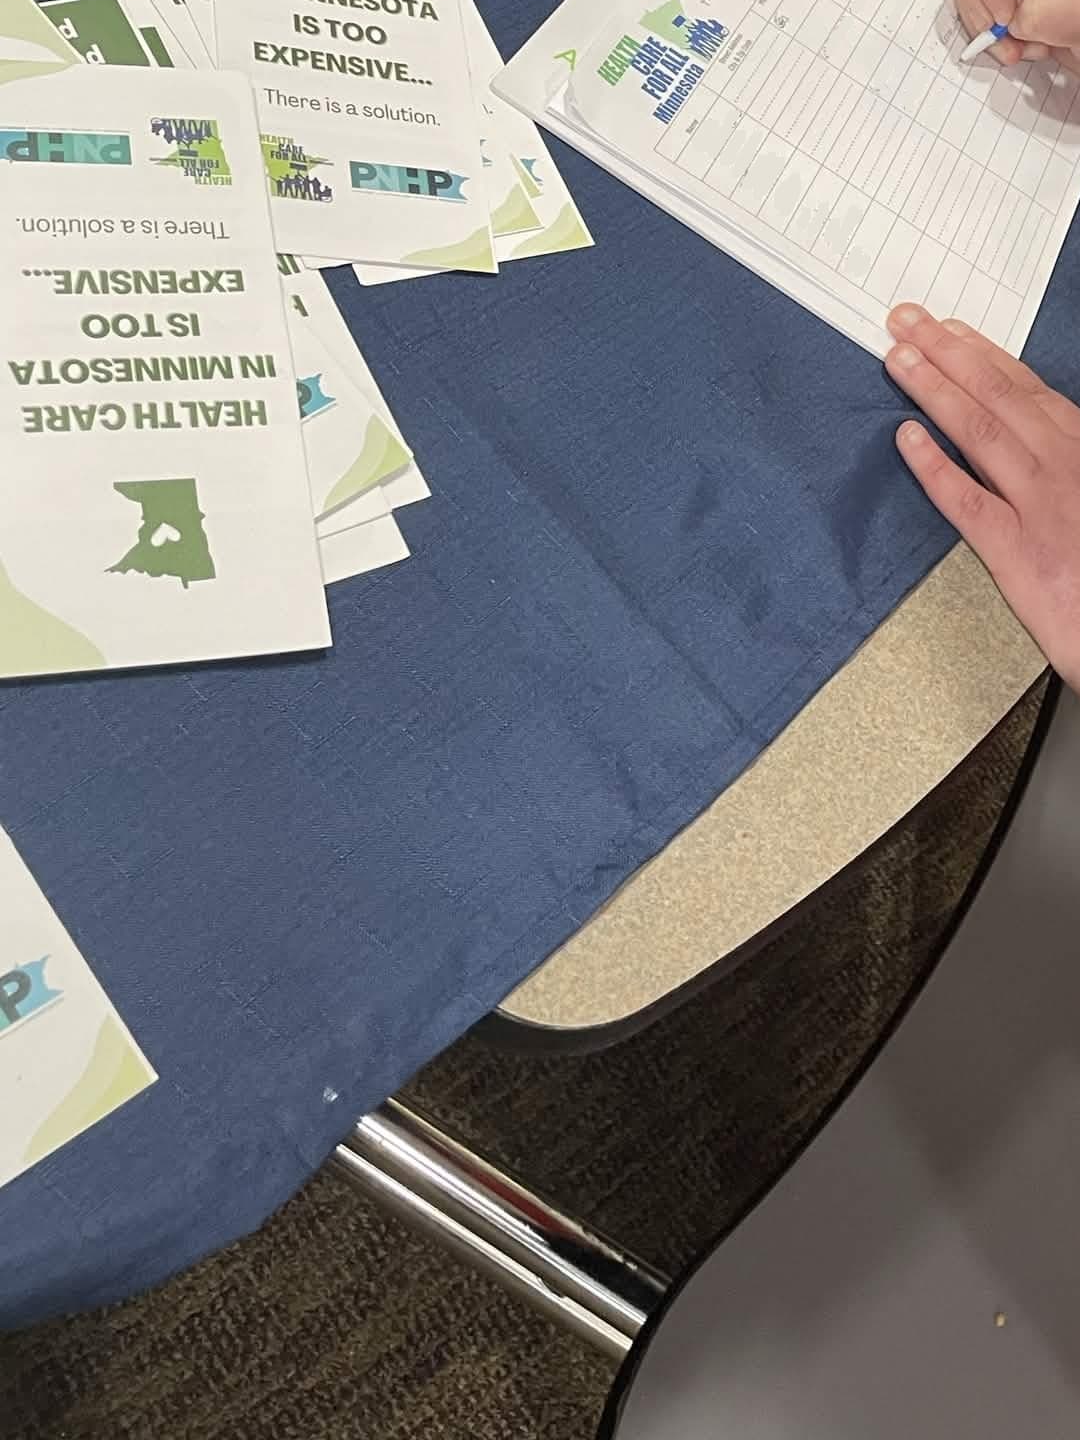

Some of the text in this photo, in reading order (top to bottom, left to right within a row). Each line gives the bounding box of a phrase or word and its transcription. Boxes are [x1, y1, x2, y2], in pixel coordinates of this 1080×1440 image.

[293, 13, 388, 46] IS TOO
[253, 41, 433, 86] EXPENSIVE...
[597, 34, 641, 86] HEALTH
[630, 36, 669, 77] CARE
[641, 47, 690, 101] FOR ALL
[264, 88, 441, 127] There is a solution.
[652, 63, 705, 125] Minnesota
[6, 132, 129, 164] PNHP
[259, 134, 294, 146] HEALTH
[270, 150, 290, 161] FOR
[278, 143, 303, 155] CARE
[183, 167, 211, 177] CARE
[203, 159, 219, 169] FOR
[351, 162, 452, 196] PNHP
[195, 175, 233, 186] HEALTH
[15, 217, 229, 239] There is a solution.
[22, 269, 245, 295] EXPENSIVE...
[81, 313, 200, 339] IS TOO
[9, 355, 277, 385] IN MINNESOTA
[22, 400, 268, 433] HEALTH CARE
